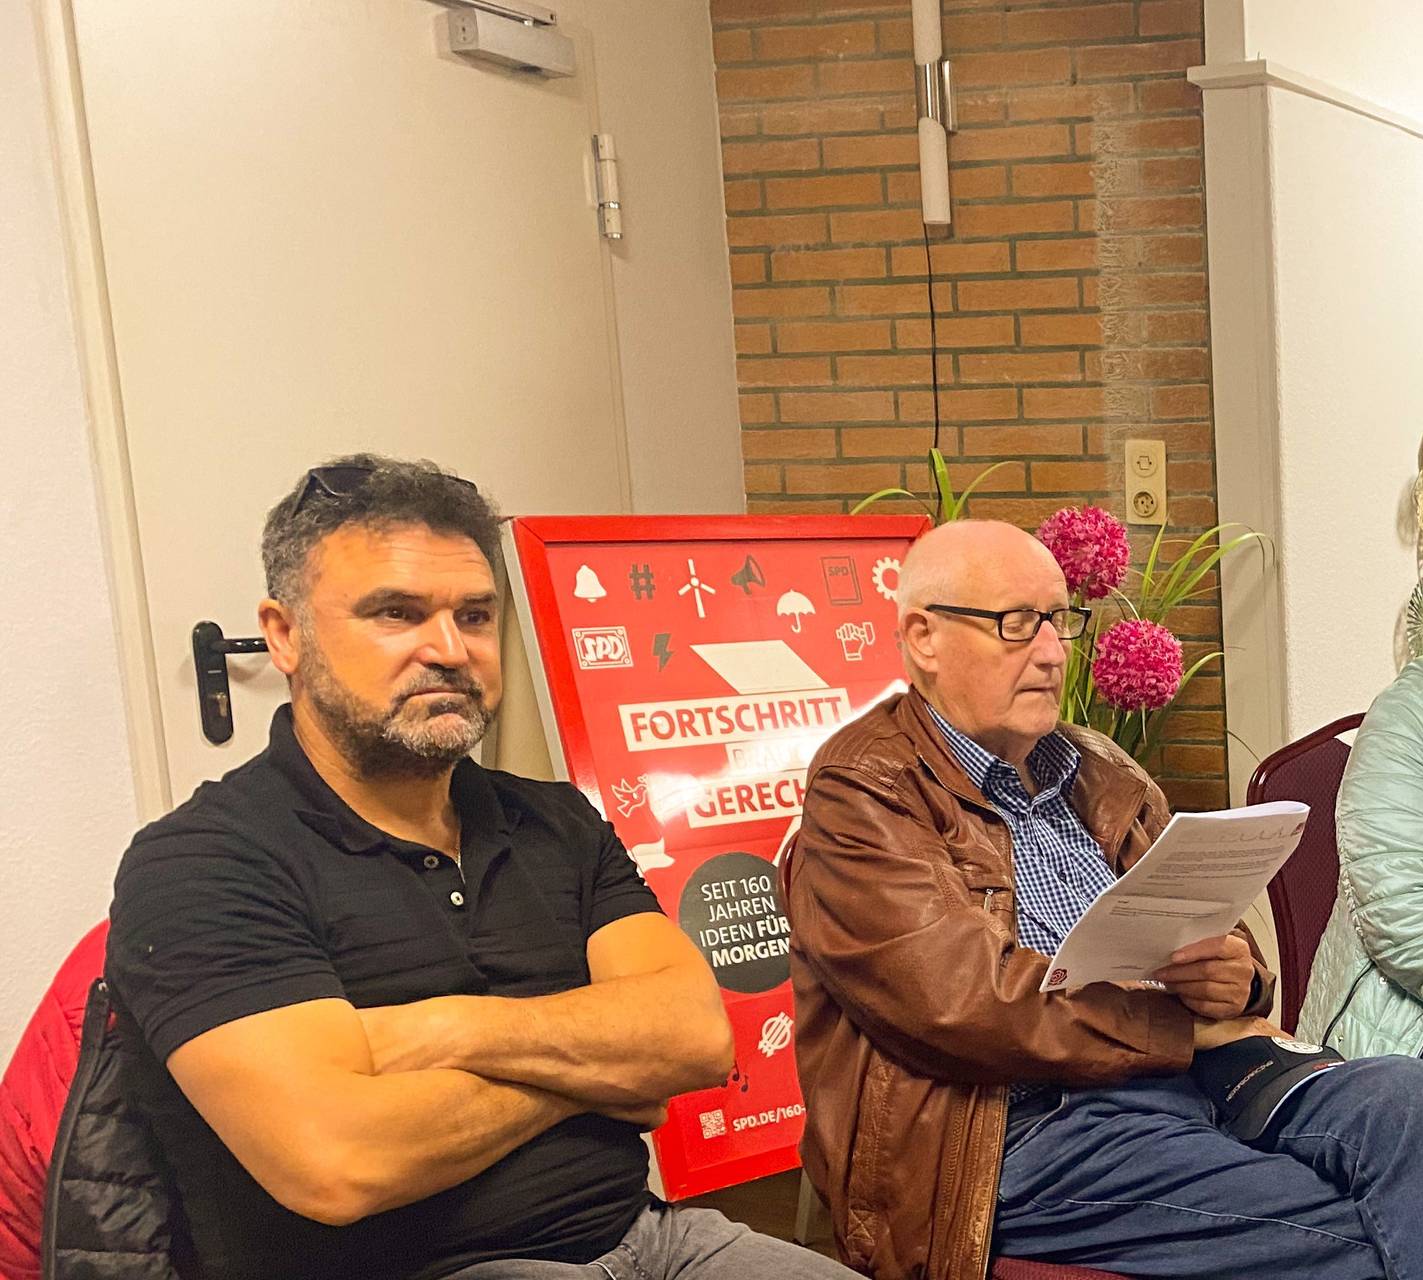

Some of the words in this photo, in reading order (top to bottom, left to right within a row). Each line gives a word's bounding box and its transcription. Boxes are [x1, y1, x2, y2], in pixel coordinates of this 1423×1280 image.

[828, 566, 849, 577] SPD
[583, 635, 625, 662] SPD
[630, 696, 842, 743] FORTSCHRITT
[694, 778, 805, 818] GERECH
[701, 880, 736, 902] SEIT
[739, 875, 771, 895] 160
[709, 895, 776, 922] JAHREN
[699, 922, 754, 947] IDEEN
[756, 914, 791, 937] FÜR
[711, 937, 790, 968] MORGEN
